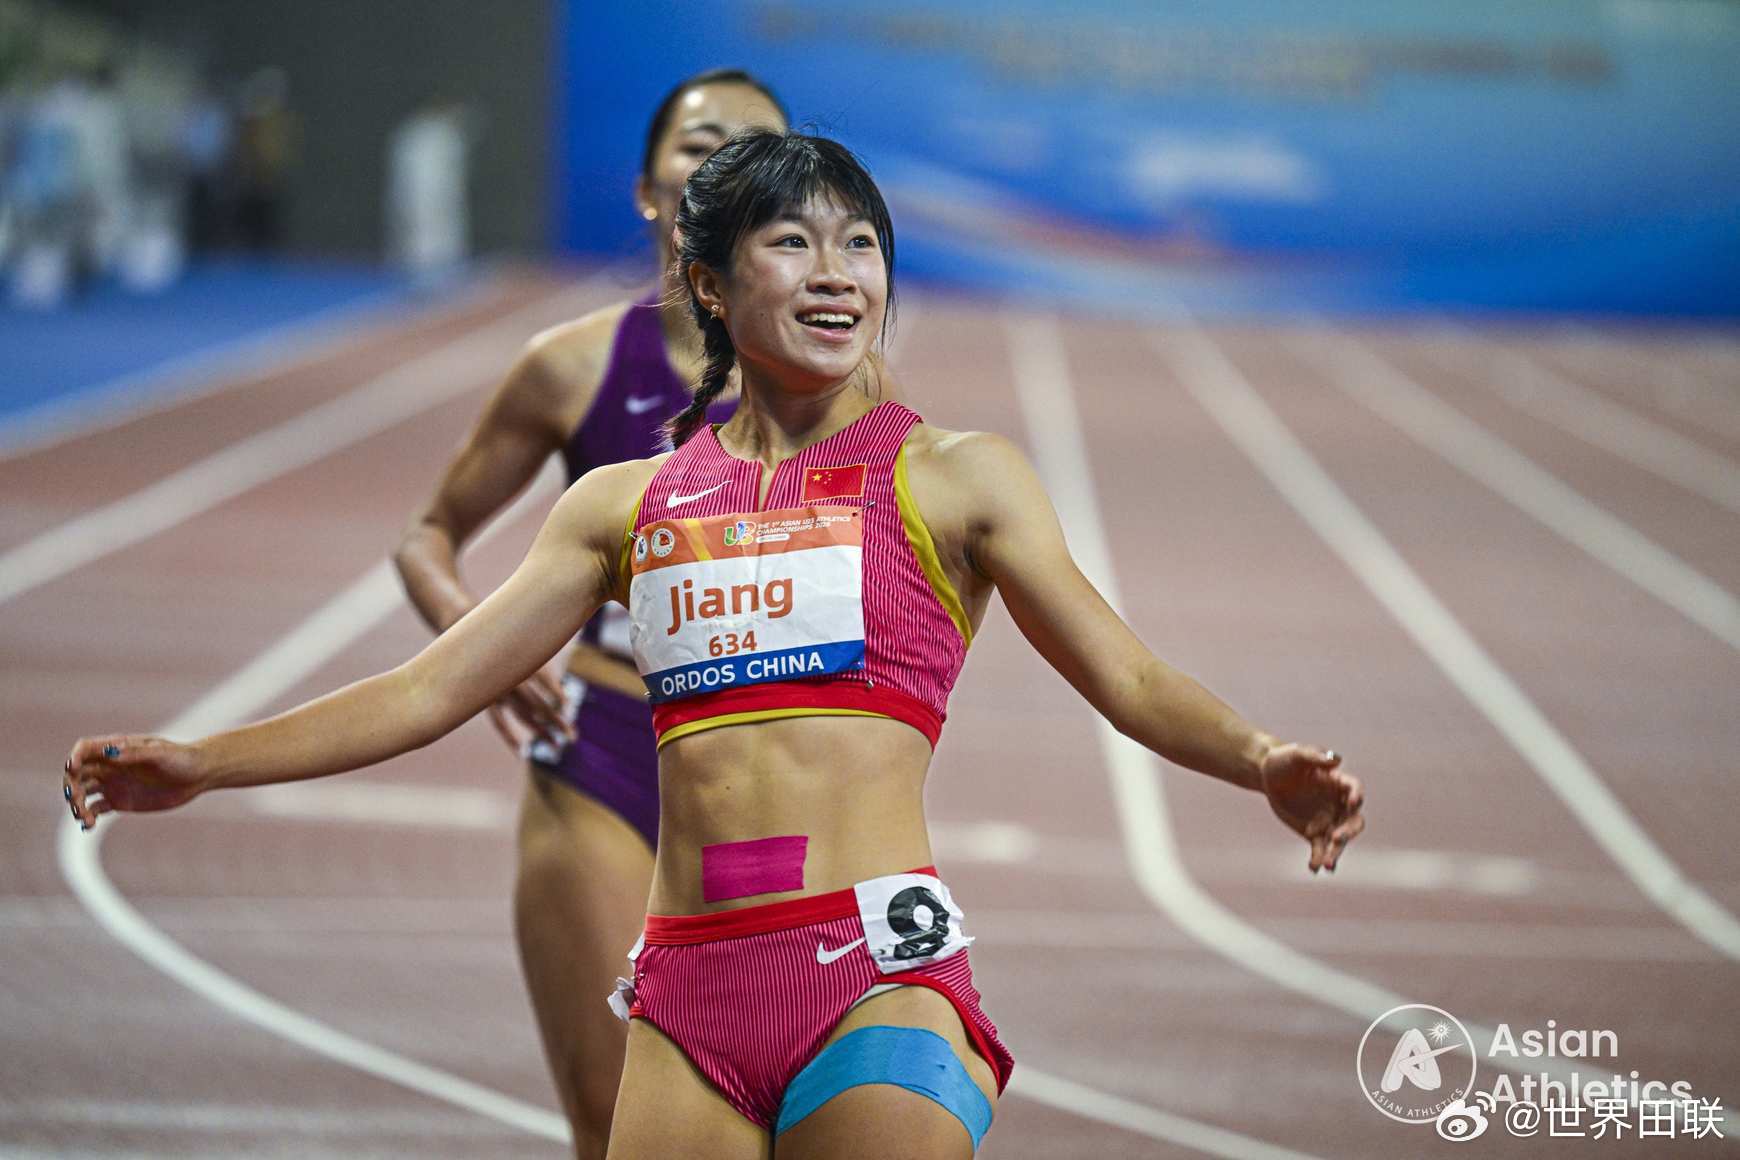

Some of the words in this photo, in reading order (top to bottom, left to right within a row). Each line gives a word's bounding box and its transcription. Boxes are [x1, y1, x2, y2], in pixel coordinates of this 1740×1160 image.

[756, 524, 814, 536] CHAMPIONSHIPS
[780, 519, 802, 527] ASIAN
[816, 515, 851, 523] ATHLETICS
[667, 577, 793, 636] Jiang
[708, 630, 757, 657] 634
[661, 664, 735, 696] ORDOS
[746, 651, 824, 680] CHINA
